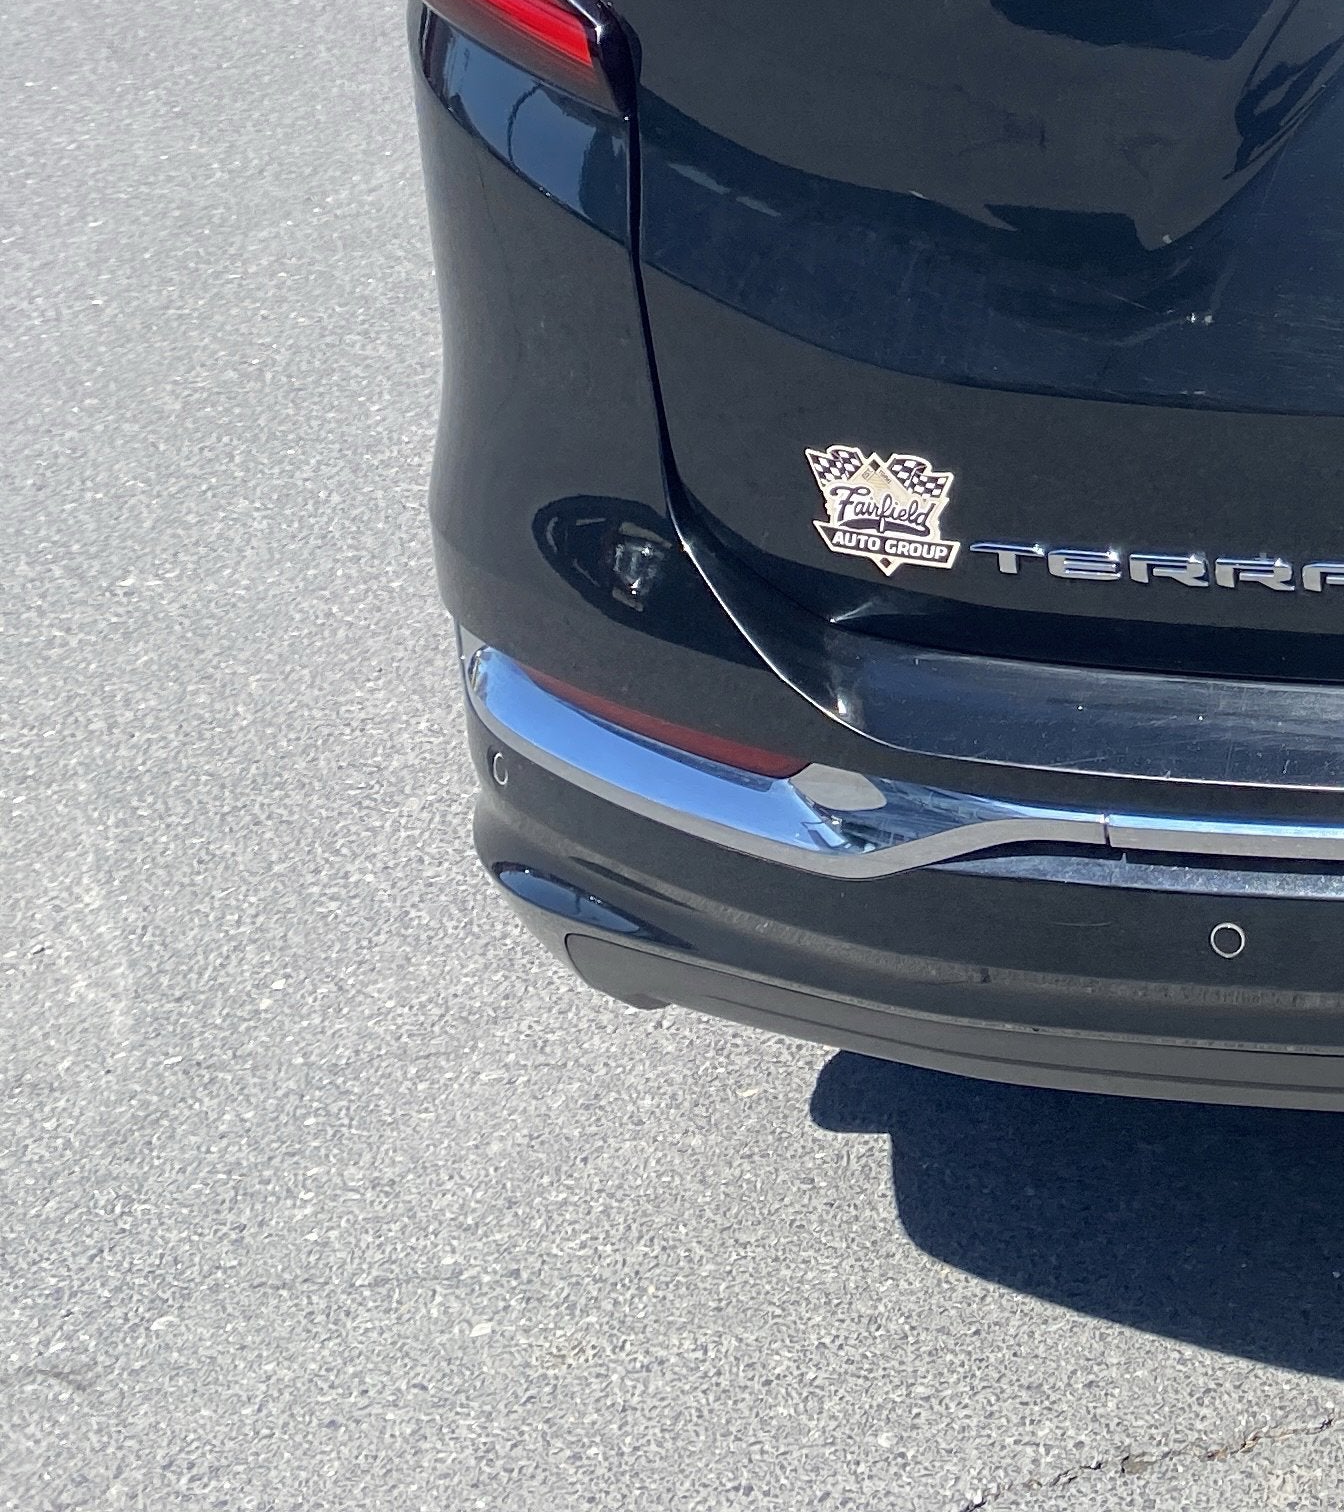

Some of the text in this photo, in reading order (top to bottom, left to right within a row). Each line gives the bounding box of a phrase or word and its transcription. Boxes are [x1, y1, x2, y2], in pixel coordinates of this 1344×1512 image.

[830, 486, 936, 530] Fairfield
[832, 531, 948, 560] AUTO GROUP
